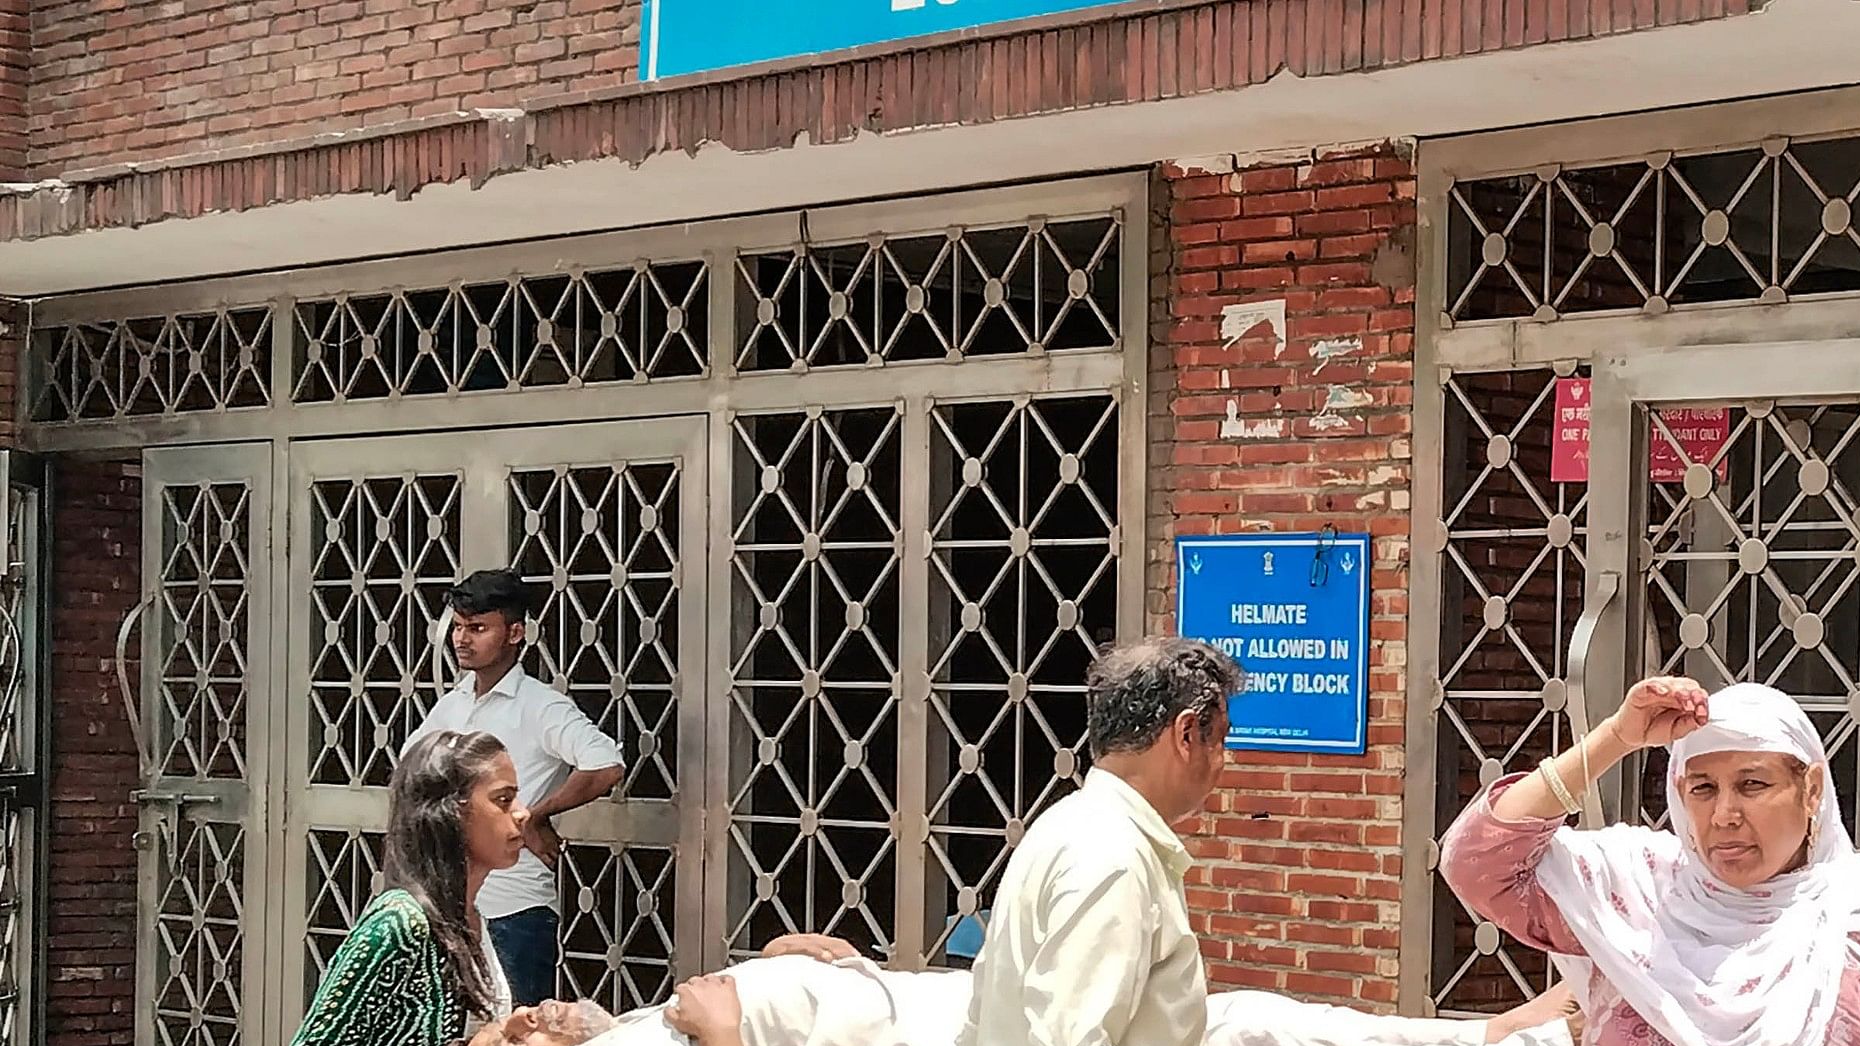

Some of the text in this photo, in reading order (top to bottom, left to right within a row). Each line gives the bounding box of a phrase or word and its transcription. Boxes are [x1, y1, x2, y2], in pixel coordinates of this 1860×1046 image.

[1561, 427, 1579, 441] ONE
[1231, 603, 1307, 624] HELMATE
[1247, 638, 1326, 659] ALLOWED
[1330, 639, 1349, 660] IN
[1292, 673, 1350, 694] BLOCK
